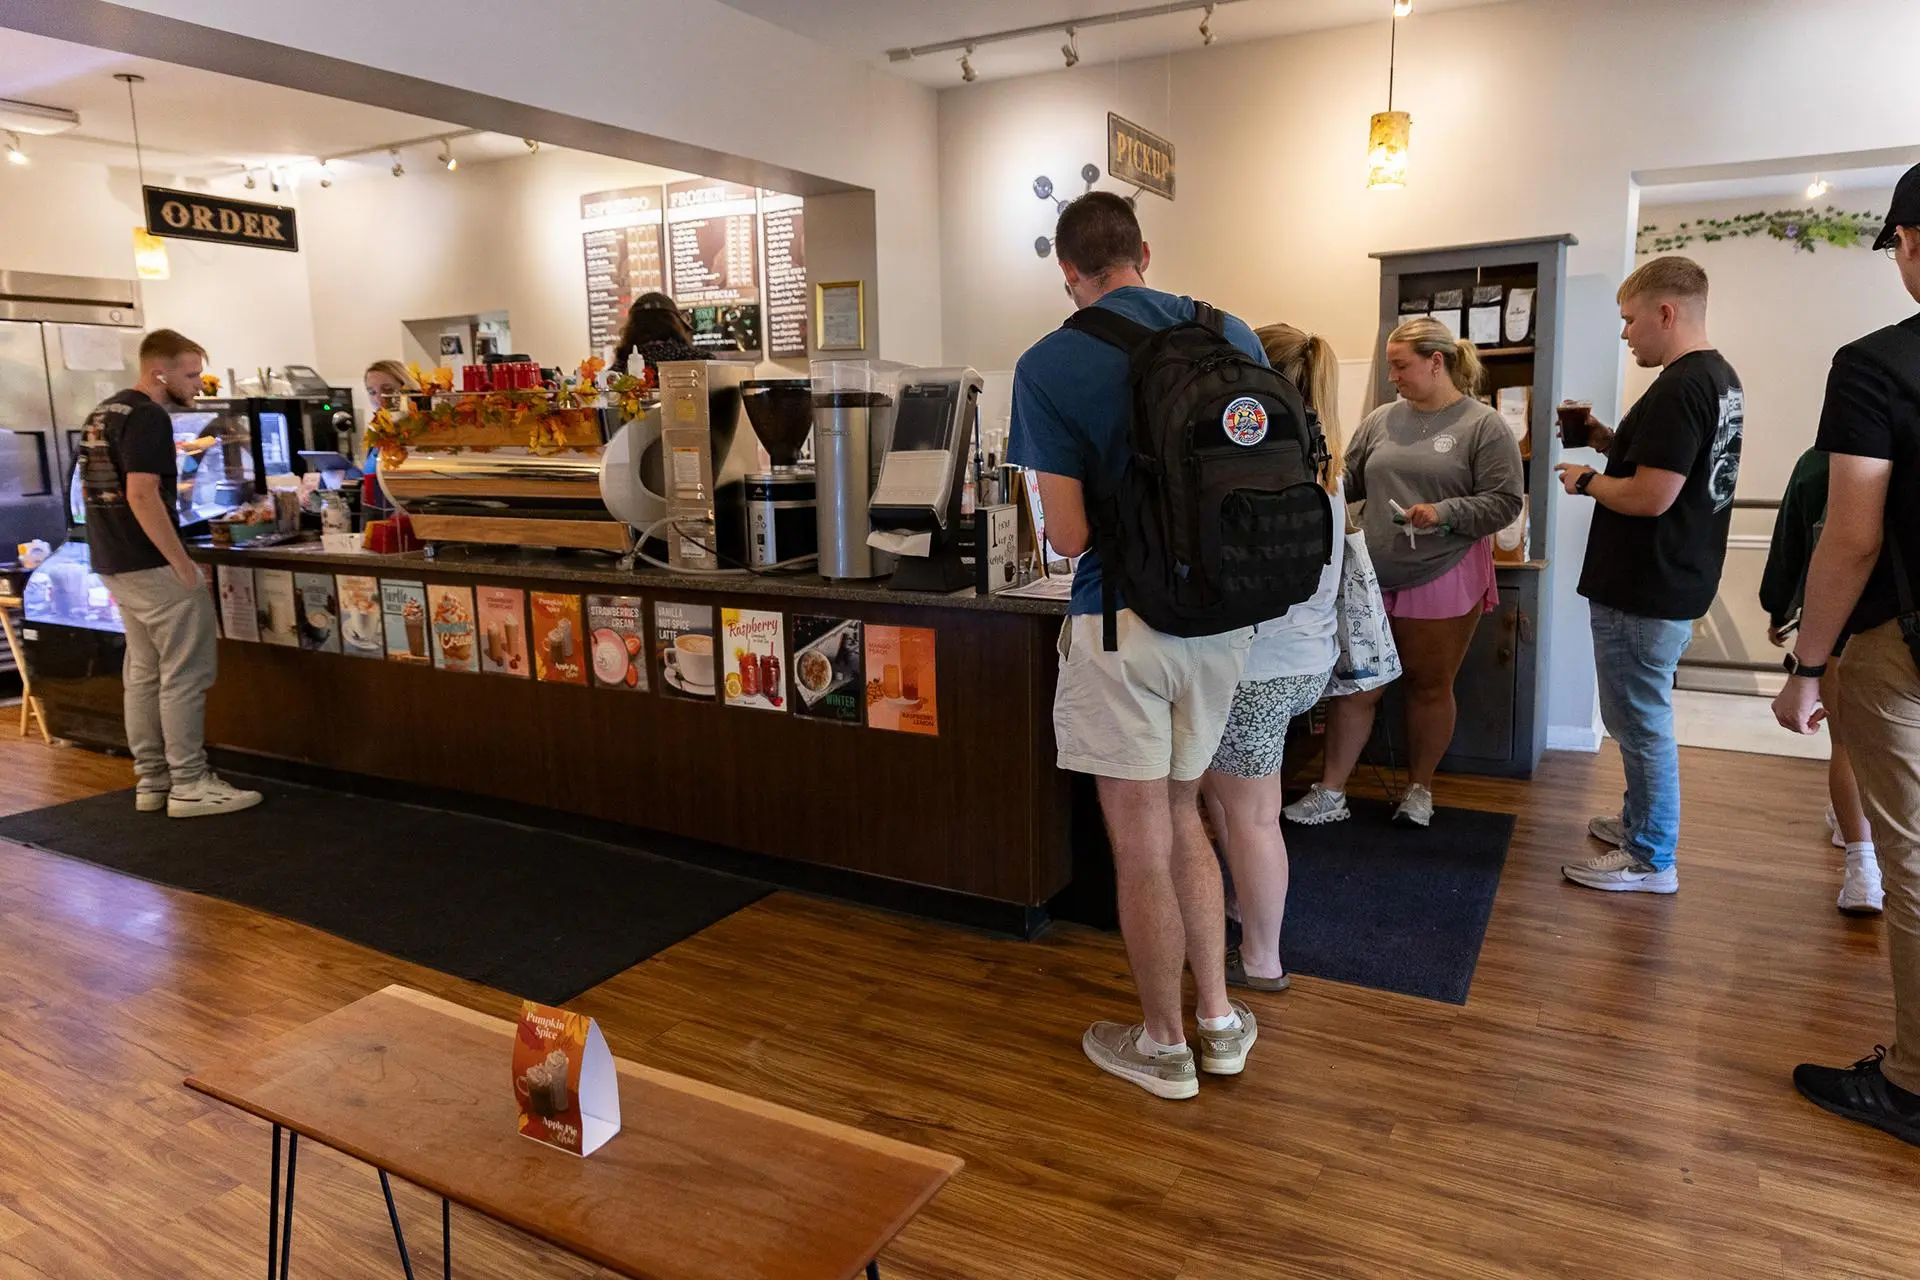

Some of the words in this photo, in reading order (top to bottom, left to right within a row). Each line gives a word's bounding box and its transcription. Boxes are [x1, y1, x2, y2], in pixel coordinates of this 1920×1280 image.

[1116, 131, 1170, 181] PICKUP
[161, 200, 286, 240] ORDER
[589, 606, 640, 618] STRAWBERRIES
[657, 607, 684, 618] VANILLA
[611, 618, 635, 629] CREAM
[658, 618, 671, 629] NUT
[671, 619, 691, 631] SPICE
[727, 616, 779, 638] Raspberry
[659, 630, 678, 641] LATTE
[826, 694, 856, 709] WINTER
[913, 719, 935, 727] LEMON
[526, 1011, 565, 1030] Pumpkin
[535, 1025, 558, 1040] Spice
[542, 1115, 564, 1132] Apple
[564, 1124, 578, 1136] Pie
